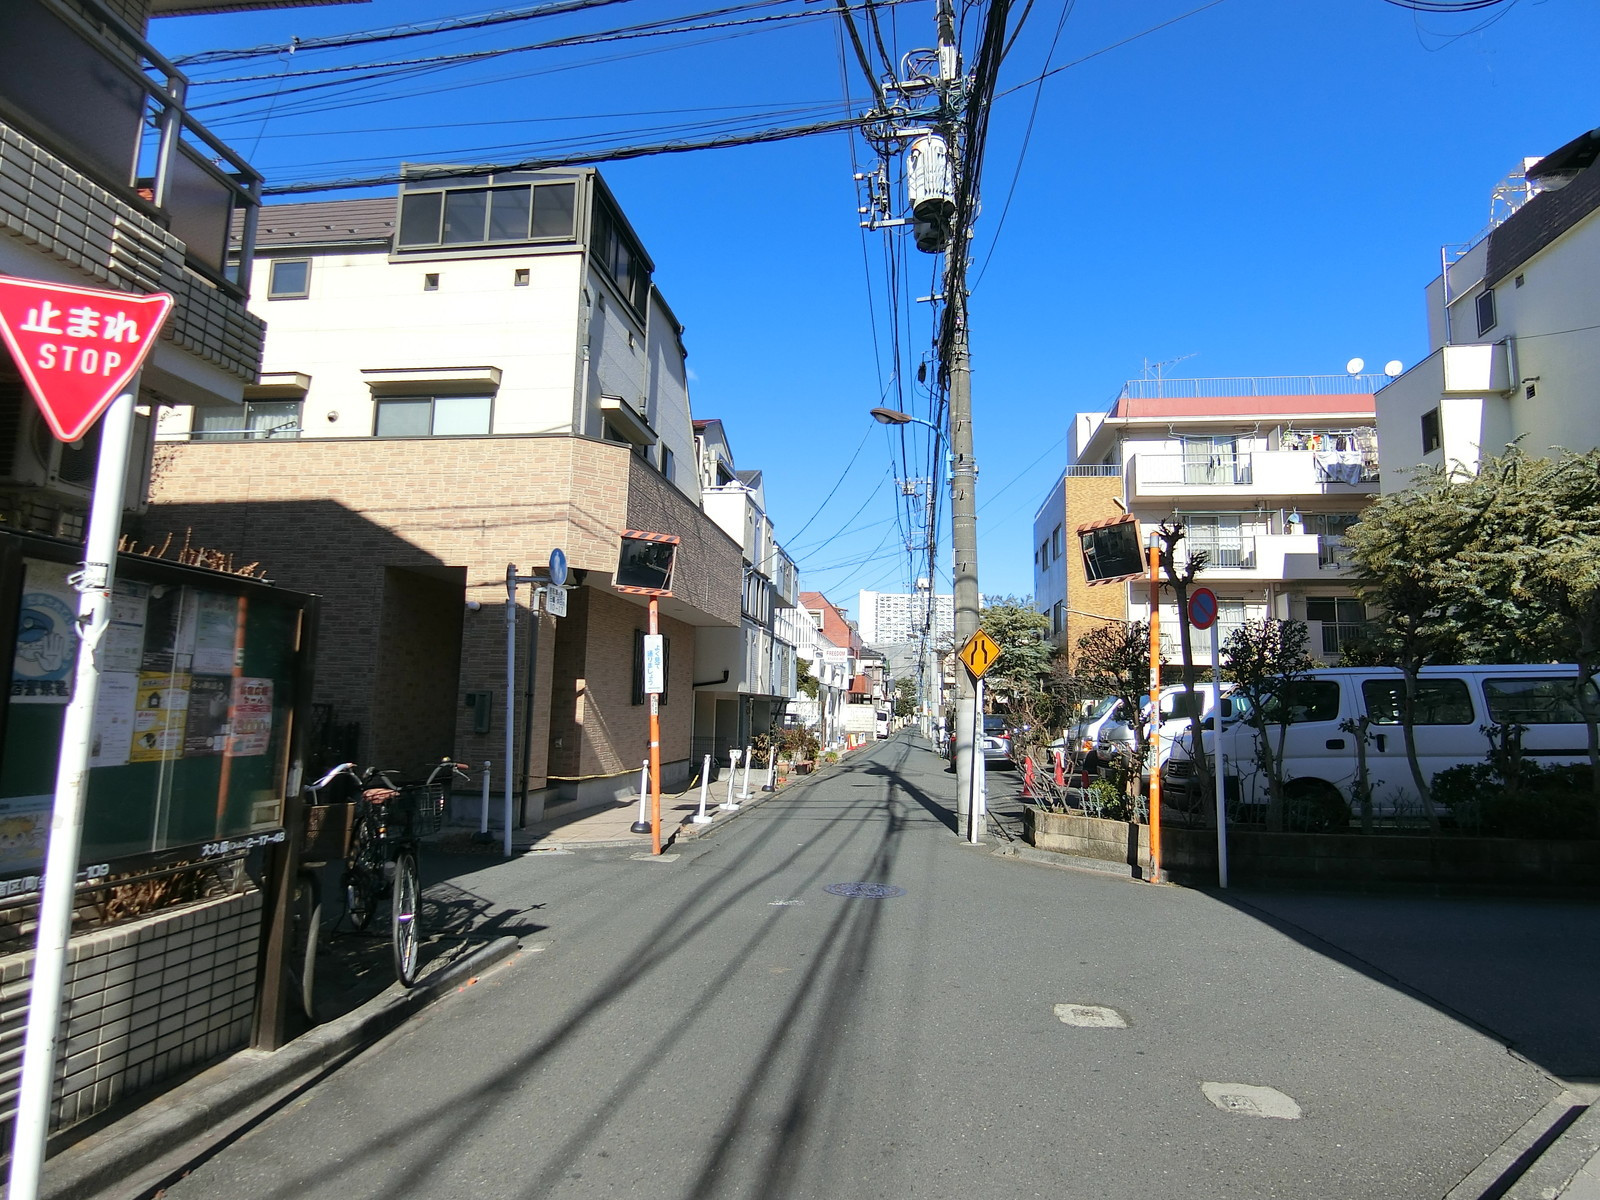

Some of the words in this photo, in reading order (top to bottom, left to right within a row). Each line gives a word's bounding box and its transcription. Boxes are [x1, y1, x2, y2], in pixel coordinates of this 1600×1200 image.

[20, 300, 141, 344] 止まれ
[37, 343, 122, 377] STOP
[243, 696, 264, 704] セール
